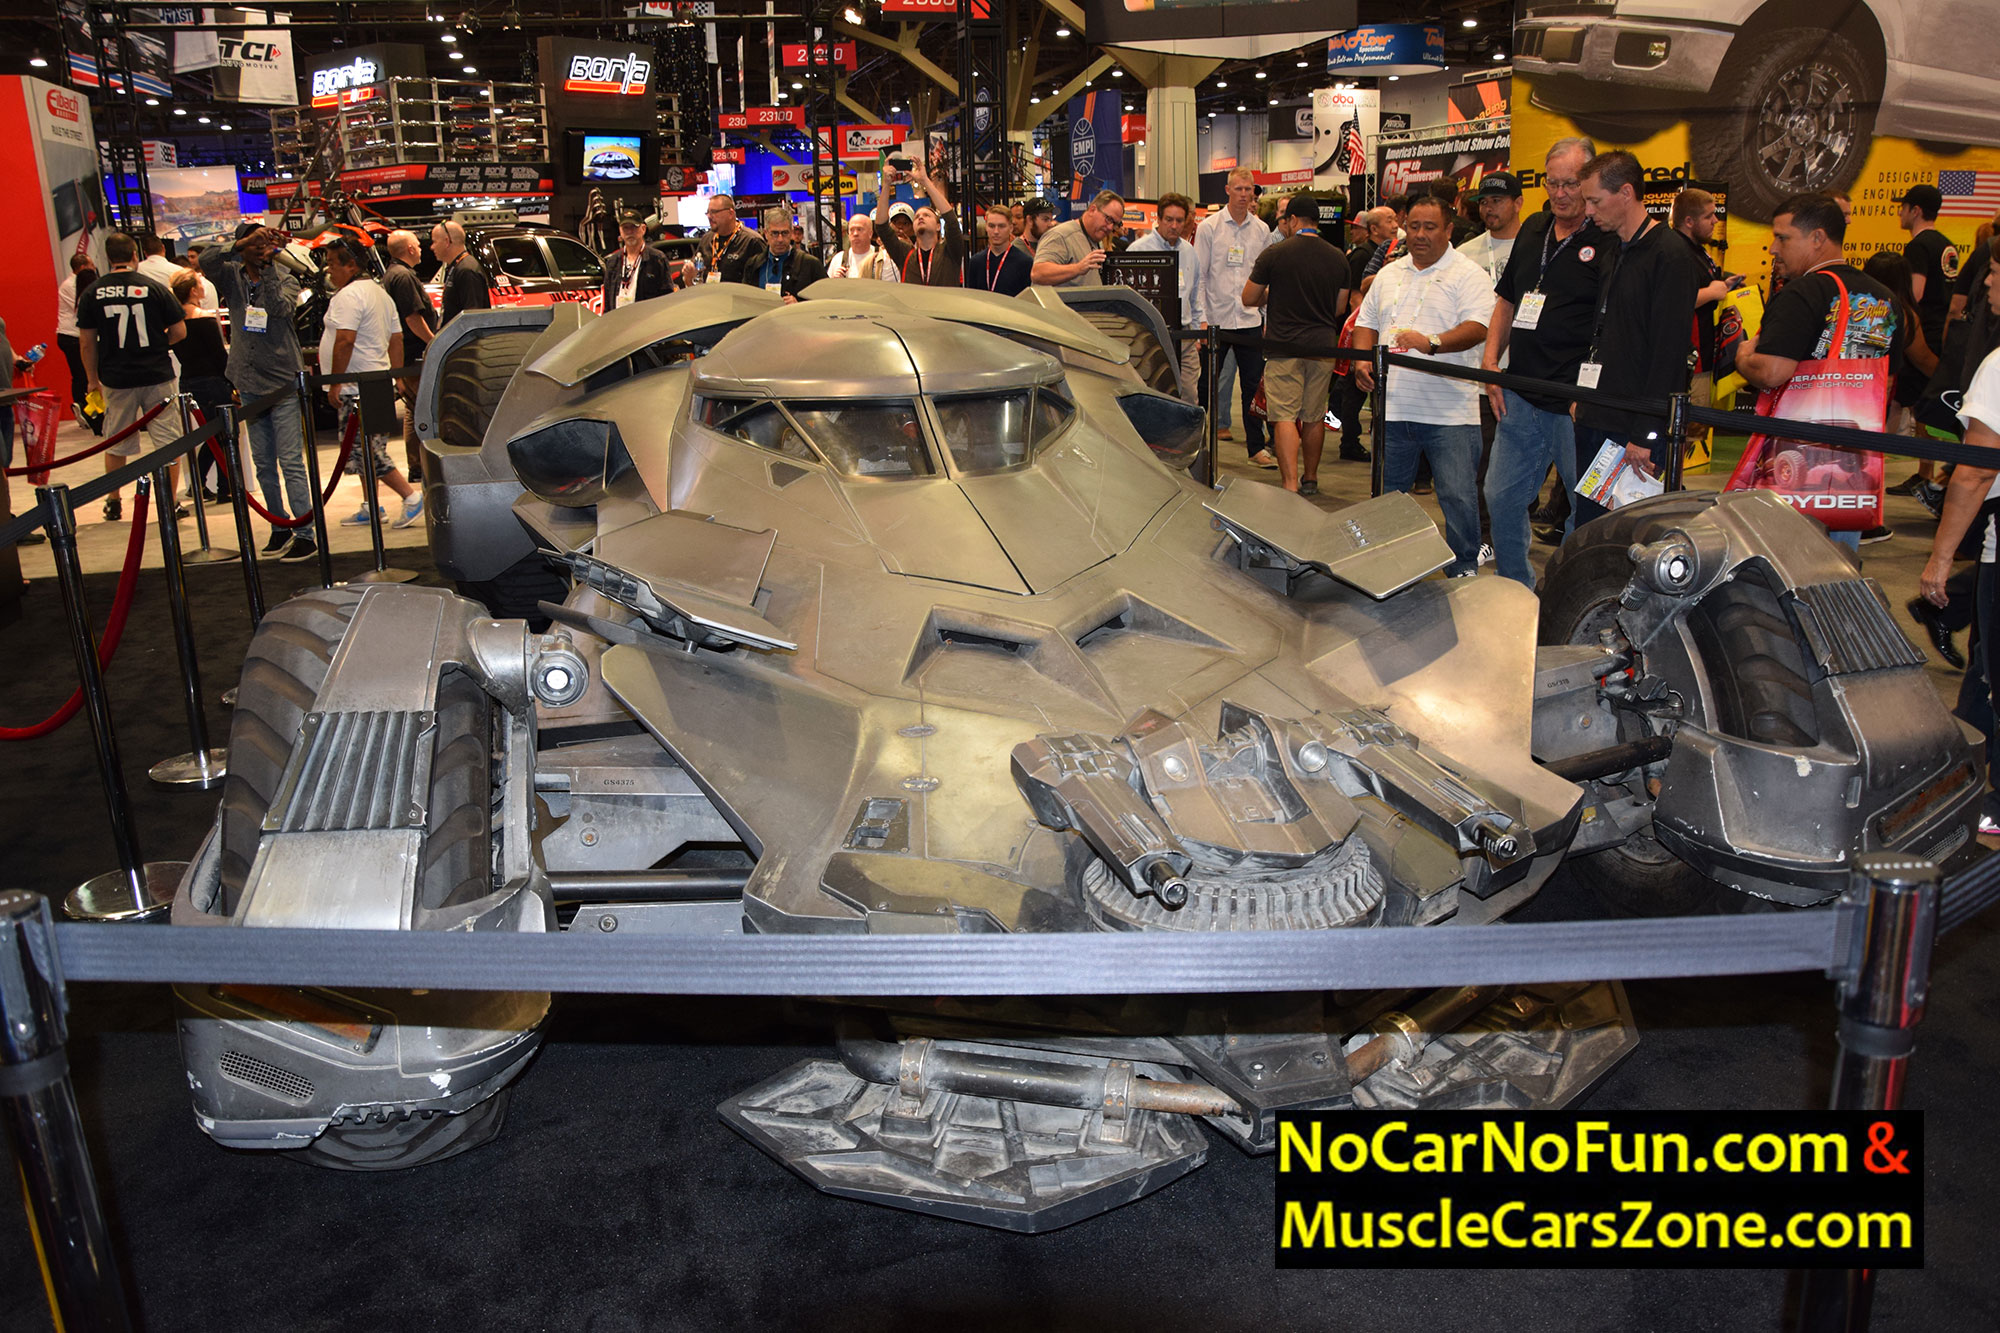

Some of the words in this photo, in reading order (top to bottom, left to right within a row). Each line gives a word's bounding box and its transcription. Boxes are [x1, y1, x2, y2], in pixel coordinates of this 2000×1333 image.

[219, 39, 278, 62] TCI
[1354, 52, 1393, 64] Performance!
[221, 59, 279, 70] AUTOMOTIVE
[1332, 93, 1354, 104] dba
[46, 89, 79, 122] Eibach
[728, 117, 747, 126] 230
[759, 110, 793, 122] 23100
[850, 135, 891, 147] McLeod
[1073, 139, 1094, 156] EMPI
[1385, 146, 1417, 160] America's
[1416, 143, 1444, 157] Greatest
[1453, 138, 1471, 152] Rod
[1470, 137, 1495, 151] Show
[1381, 160, 1413, 199] 65
[1878, 171, 1933, 183] DESIGNED
[1860, 243, 1872, 251] TO
[96, 285, 125, 300] SSR
[104, 303, 150, 349] 71
[1816, 381, 1864, 389] LIGHTING
